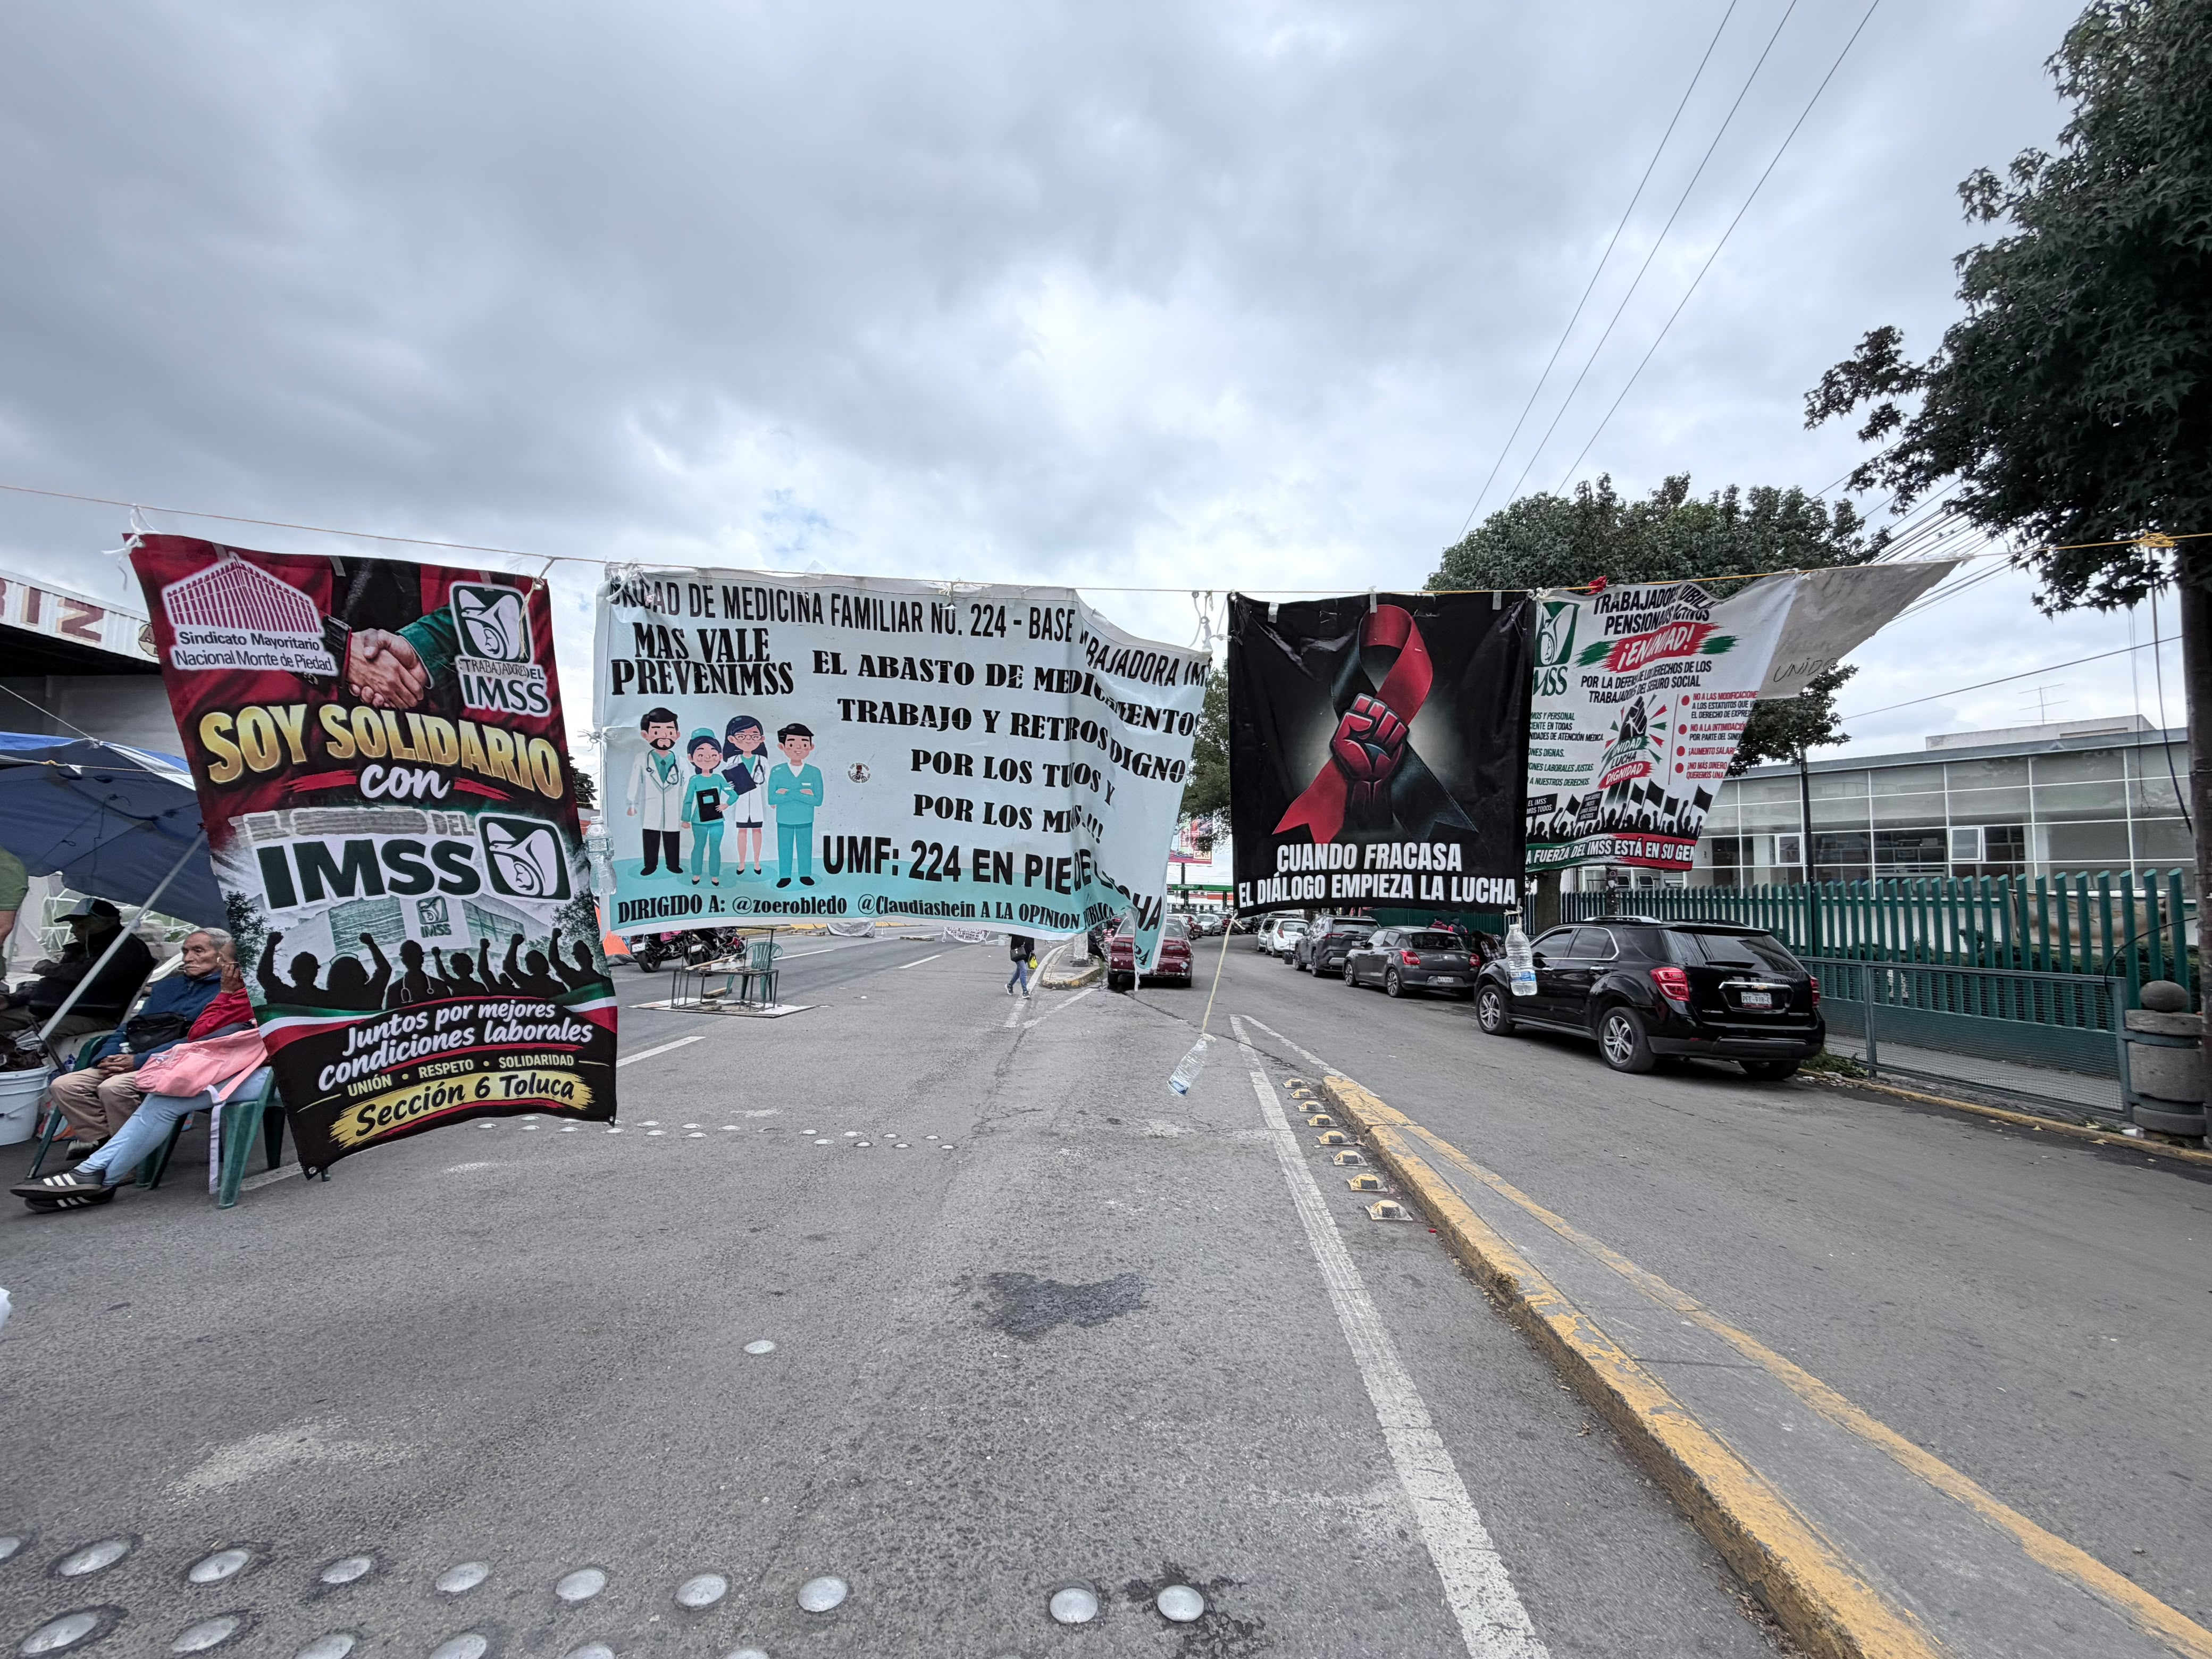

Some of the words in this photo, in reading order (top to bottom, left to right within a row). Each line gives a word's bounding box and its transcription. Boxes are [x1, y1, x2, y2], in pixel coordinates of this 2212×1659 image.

[0, 577, 105, 643] IZ
[688, 583, 716, 618] DE
[722, 585, 824, 624] MEDICINA
[831, 593, 924, 633] FAMILIAR
[970, 604, 1007, 638] 224
[1029, 607, 1076, 643] BASE
[179, 631, 247, 646] Sindicato
[250, 633, 320, 651] Mayoritario
[633, 622, 690, 660] MAS
[697, 627, 770, 663] VALE
[174, 650, 235, 666] Nacional
[236, 650, 279, 666] Monte
[280, 653, 293, 667] de
[295, 654, 332, 672] Piedad
[459, 659, 527, 677] TRABAJADORES
[611, 659, 794, 696] PREVENIMSS
[812, 650, 848, 675] EL
[858, 654, 975, 686] ABASTO
[985, 663, 1024, 690] DE
[1580, 676, 1599, 688] POR
[1601, 676, 1614, 689] LA
[1683, 661, 1695, 673] DE
[1695, 660, 1712, 673] LOS
[463, 674, 549, 713] IMSS
[1671, 675, 1701, 689] SOCIAL
[837, 698, 971, 732] TRABAJO
[983, 709, 1001, 734] Y
[1547, 712, 1575, 720] PERSONAL
[1708, 701, 1737, 709] ESTATUTOS
[1737, 700, 1749, 709] QUE
[1547, 722, 1554, 730] EN
[1555, 722, 1573, 731] TODAS
[1557, 731, 1585, 741] ATENCIÓN
[199, 703, 308, 784] SOY
[319, 705, 564, 800] SOLIDARIO
[1544, 764, 1575, 772] LABORALES
[1610, 751, 1637, 769] LUCHA
[360, 764, 451, 799] con
[911, 748, 974, 777] POR
[983, 756, 1033, 785] LOS
[1104, 779, 1116, 806] Y
[1535, 777, 1563, 786] NUESTROS
[1606, 763, 1644, 786] DIGNIDAD
[1686, 771, 1712, 780] QUEREMOS
[913, 793, 973, 823] POR
[983, 802, 1032, 831] LOS
[1537, 804, 1553, 813] TODOS
[823, 835, 900, 877] UMF:
[909, 839, 961, 883] 224
[973, 848, 1013, 886] EN
[1024, 853, 1072, 895] PIE
[1276, 843, 1357, 873] CUANDO
[1363, 843, 1463, 873] FRACASA
[1534, 847, 1569, 864] FUERZA
[1570, 844, 1585, 858] DEL
[1587, 840, 1612, 856] IMSS
[1614, 837, 1643, 857] ESTÁ
[1646, 842, 1660, 859] EN
[1661, 844, 1674, 860] SU
[256, 839, 481, 910] IMSS
[1238, 883, 1254, 908] EL
[1258, 872, 1326, 905] DIÁLOGO
[1331, 874, 1413, 900] EMPIEZA
[1420, 876, 1445, 901] LA
[1452, 877, 1516, 904] LUCHA
[617, 894, 703, 924] DIRIGIDO
[708, 895, 726, 913] A:
[732, 895, 847, 915] @zoerobledo
[858, 893, 976, 918] @Claudiashein
[981, 901, 991, 918] A
[995, 902, 1013, 920] LA
[1018, 903, 1080, 930] OPINION
[420, 923, 452, 939] IMSS
[342, 1012, 429, 1057] Juntos
[434, 1004, 474, 1032] por
[477, 1000, 555, 1023] mejores
[319, 1026, 475, 1092] condiciones
[483, 1018, 593, 1043] laborales
[347, 1073, 392, 1097] UNIÓN
[418, 1059, 474, 1079] RESPETO
[499, 1054, 575, 1069] SOLIDARIDAD
[355, 1082, 466, 1137] Sección
[474, 1076, 490, 1100] 6
[499, 1072, 575, 1101] Toluca
